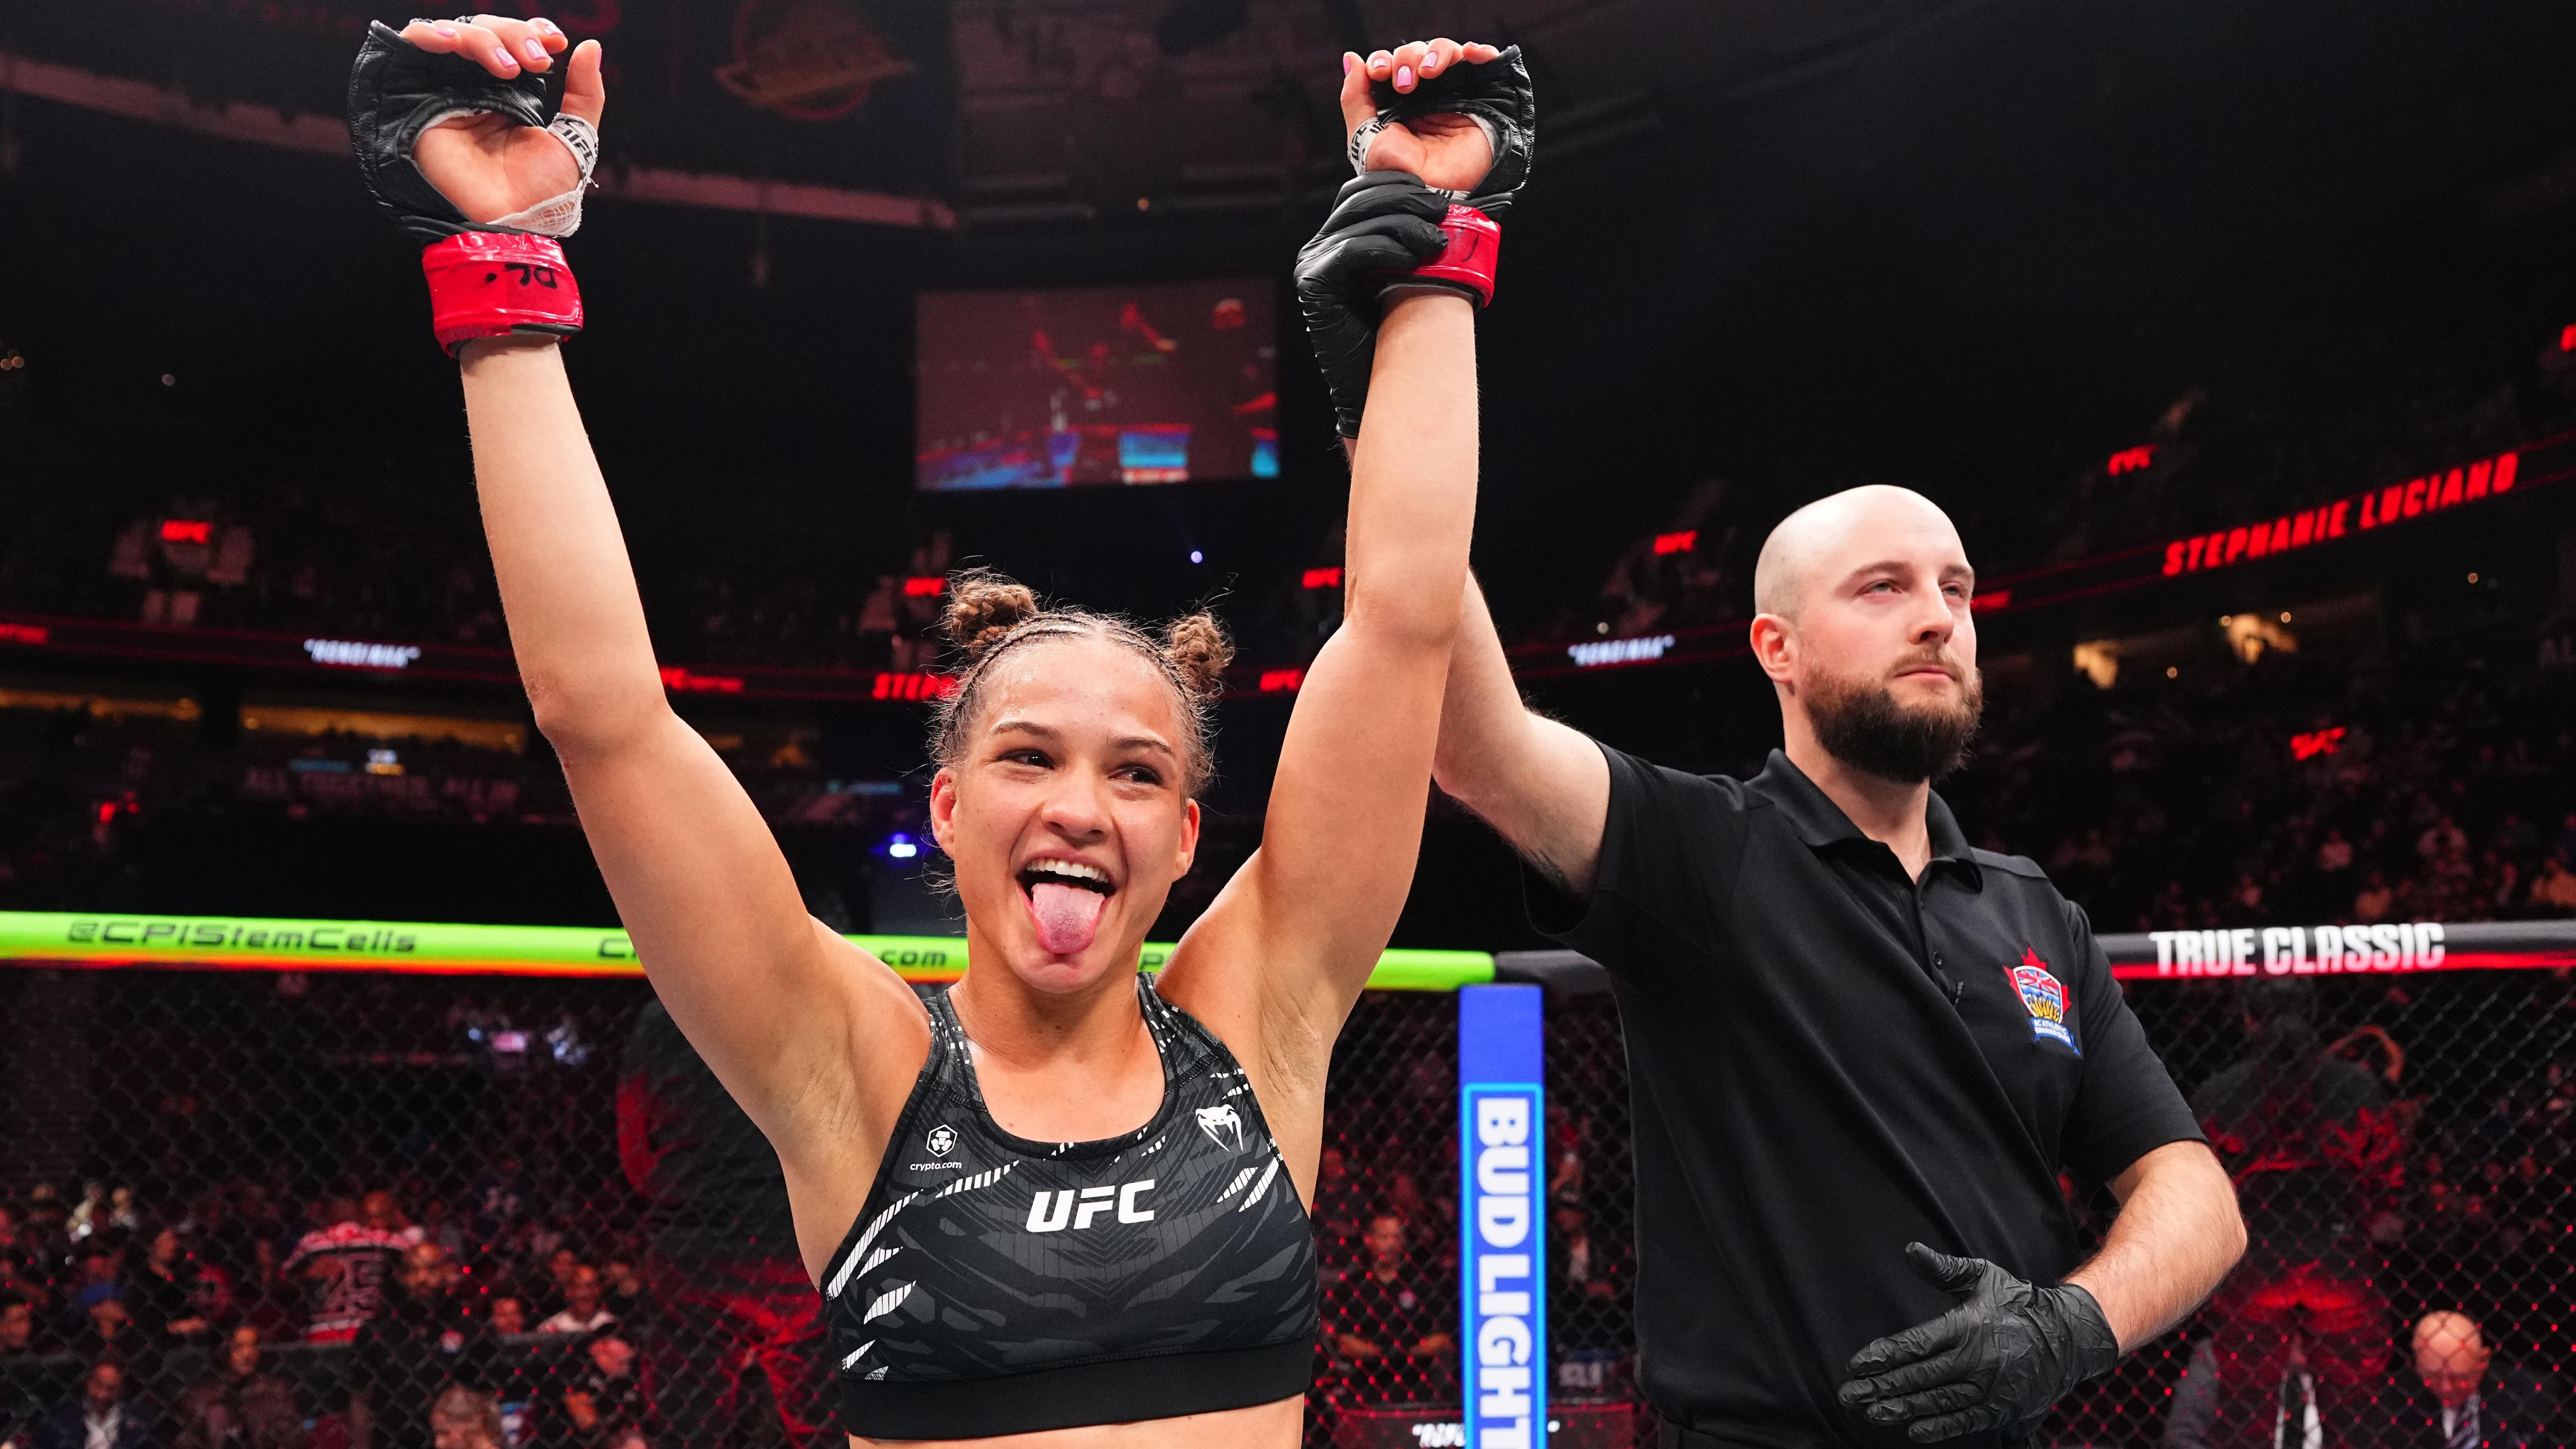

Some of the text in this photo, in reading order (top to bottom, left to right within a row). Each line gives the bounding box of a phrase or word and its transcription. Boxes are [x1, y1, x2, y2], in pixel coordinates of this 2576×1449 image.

[2162, 451, 2519, 577] STEPHANIE LUCIANO
[2148, 922, 2446, 976] TRUE CLASSIC
[909, 1162, 962, 1172] crypto.com
[1477, 1097, 1531, 1249] BUD
[1025, 1178, 1155, 1233] UFC
